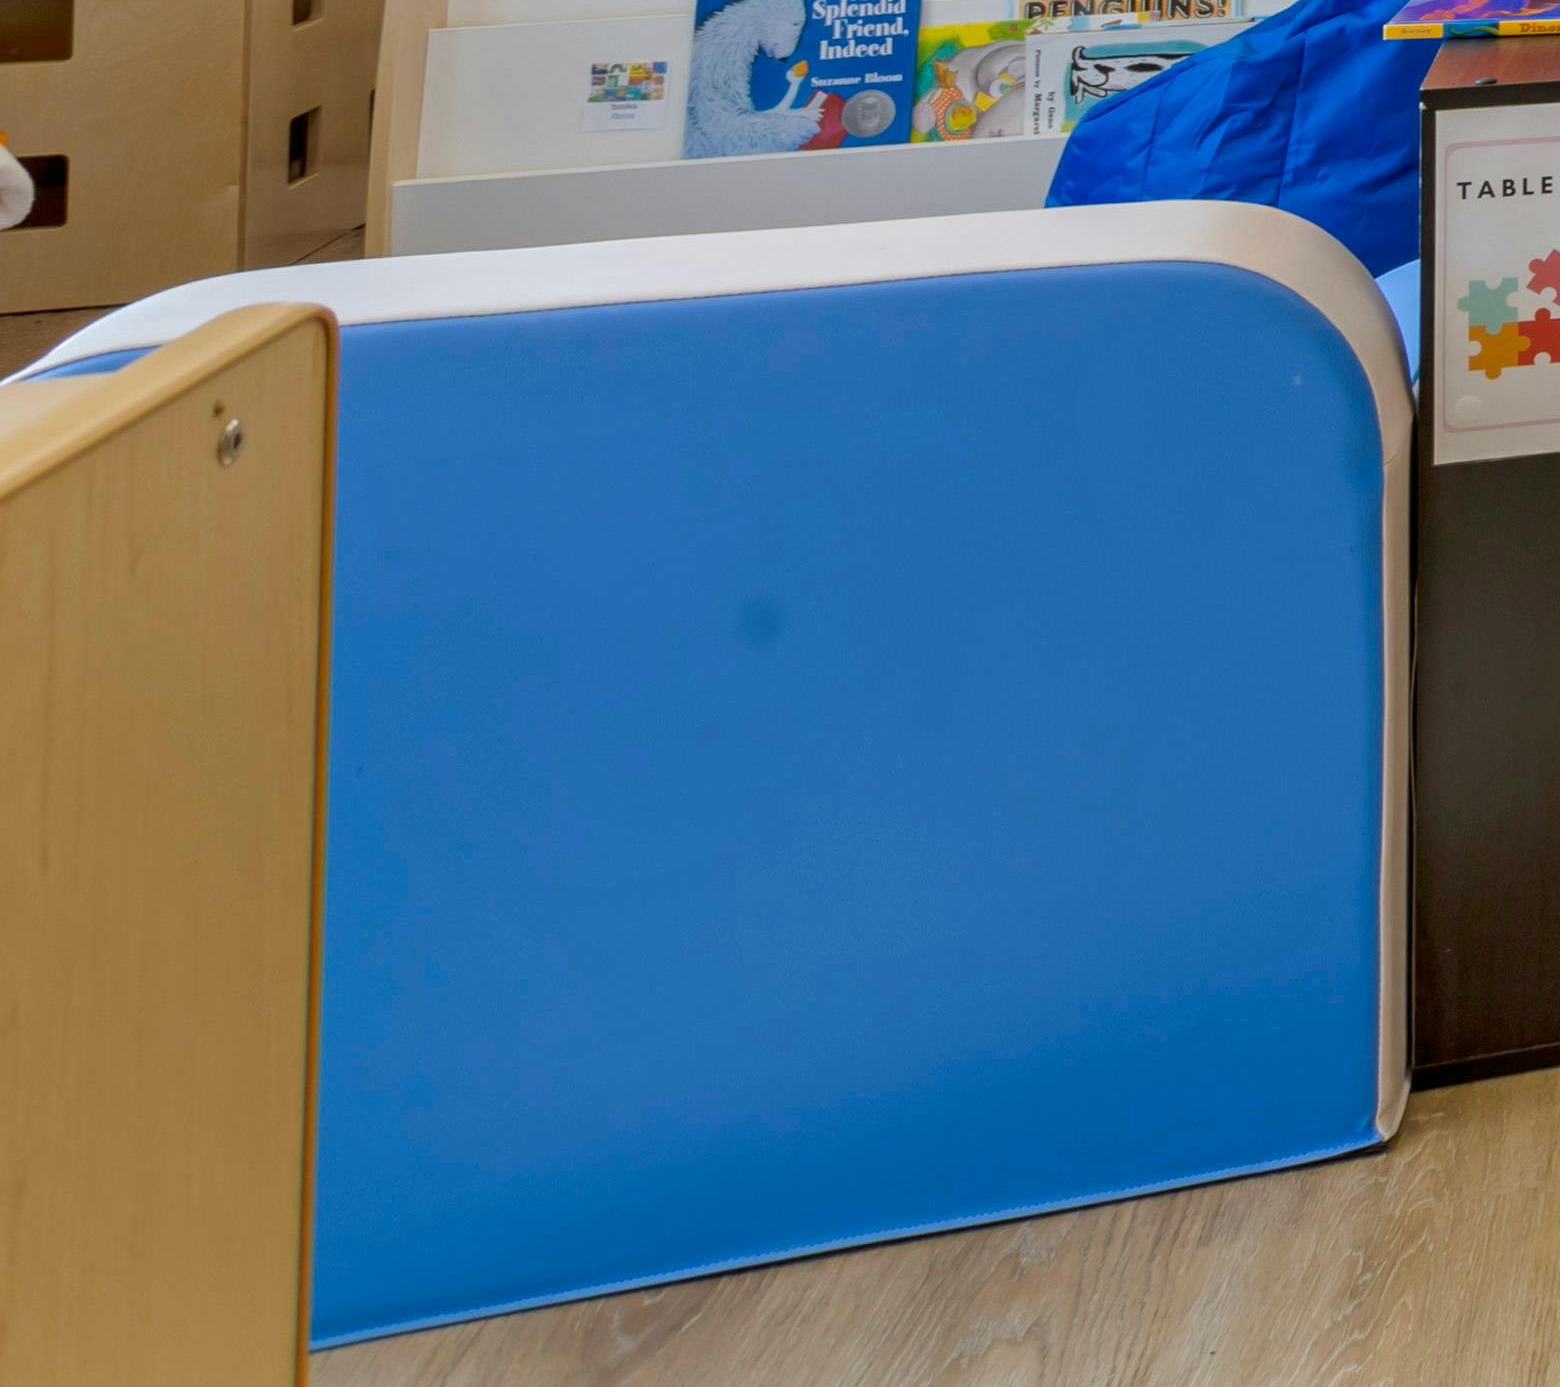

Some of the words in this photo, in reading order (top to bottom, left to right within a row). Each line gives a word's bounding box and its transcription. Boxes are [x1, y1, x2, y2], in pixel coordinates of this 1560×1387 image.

[832, 17, 910, 39] Friend,
[819, 38, 892, 61] Indeed
[811, 75, 861, 87] Suzanne
[864, 73, 902, 84] Bloom
[1457, 176, 1554, 200] TABLE
